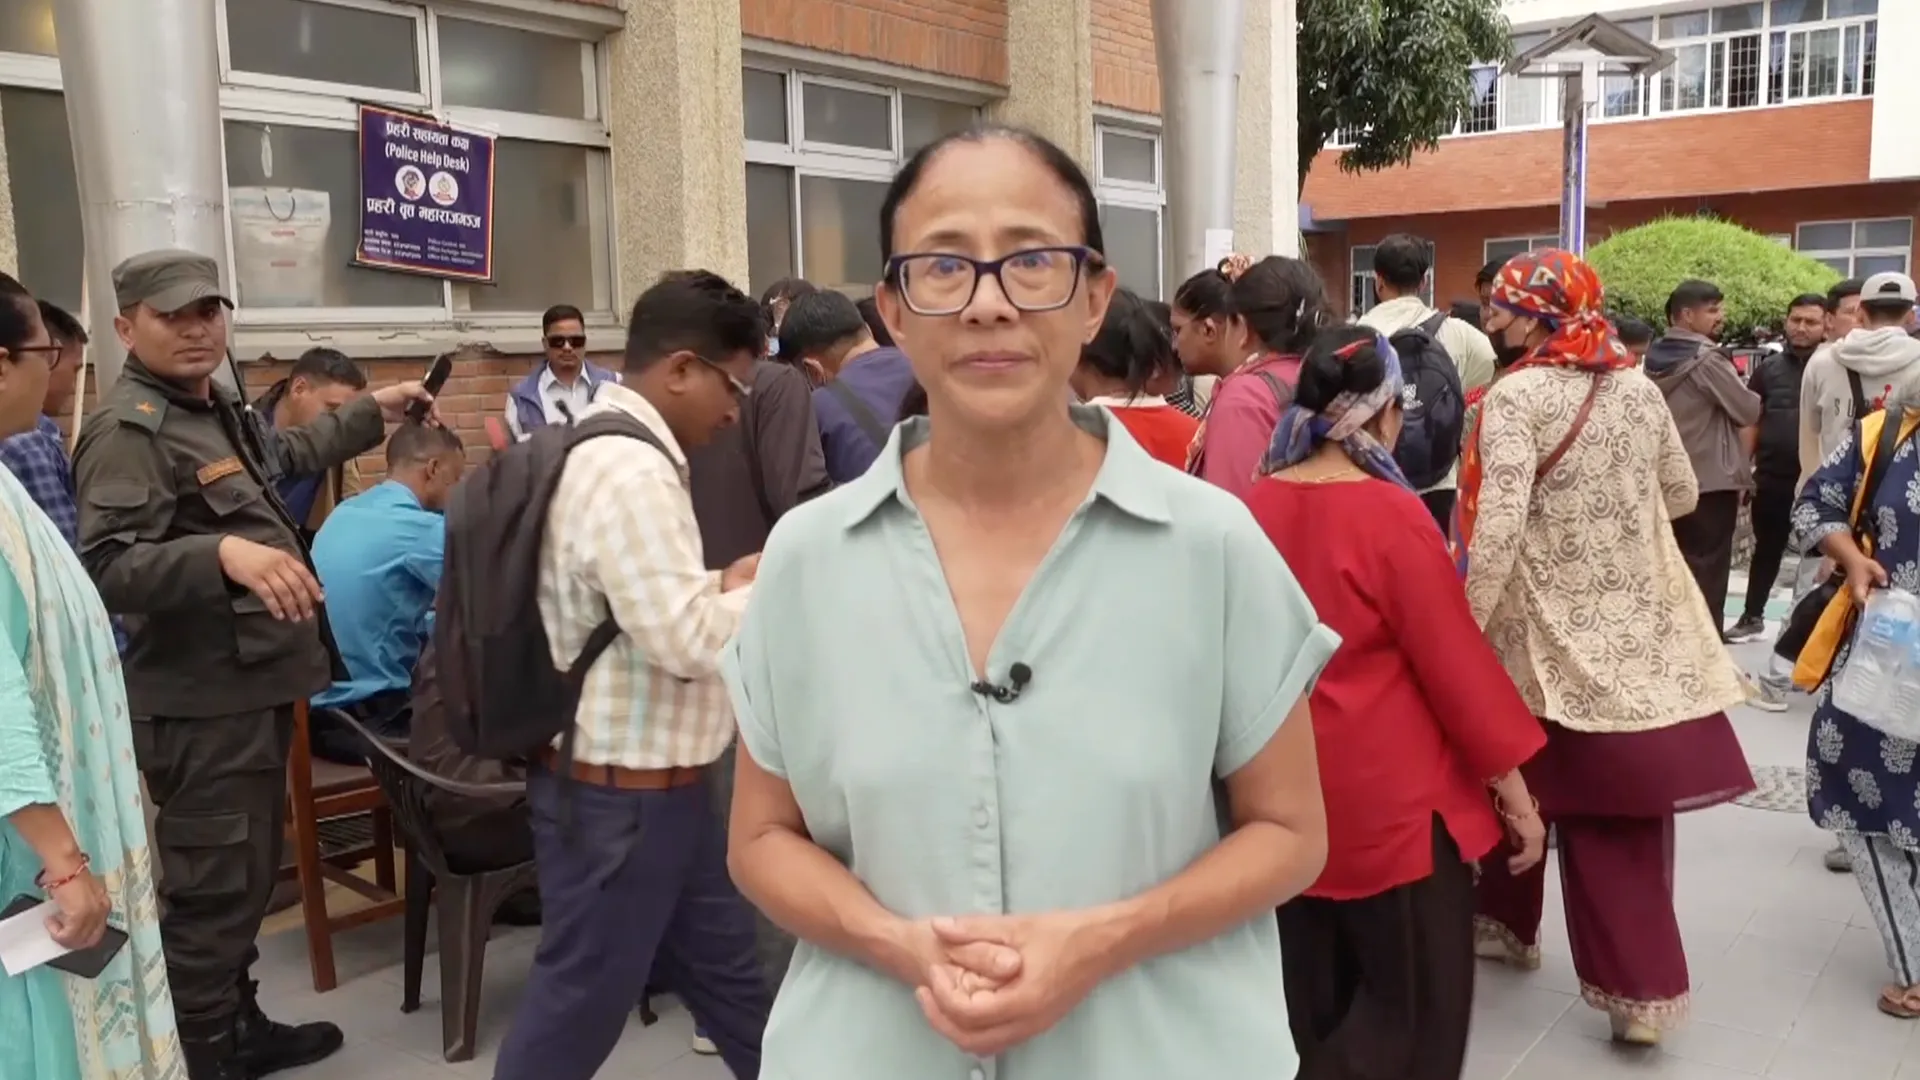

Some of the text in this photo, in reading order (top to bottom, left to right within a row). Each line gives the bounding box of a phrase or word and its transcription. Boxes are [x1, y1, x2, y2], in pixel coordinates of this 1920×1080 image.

[386, 121, 470, 151] प्रहरी सहायता कक्ष
[385, 141, 470, 174] (Police Help Desk)
[366, 197, 396, 215] प्रहरी
